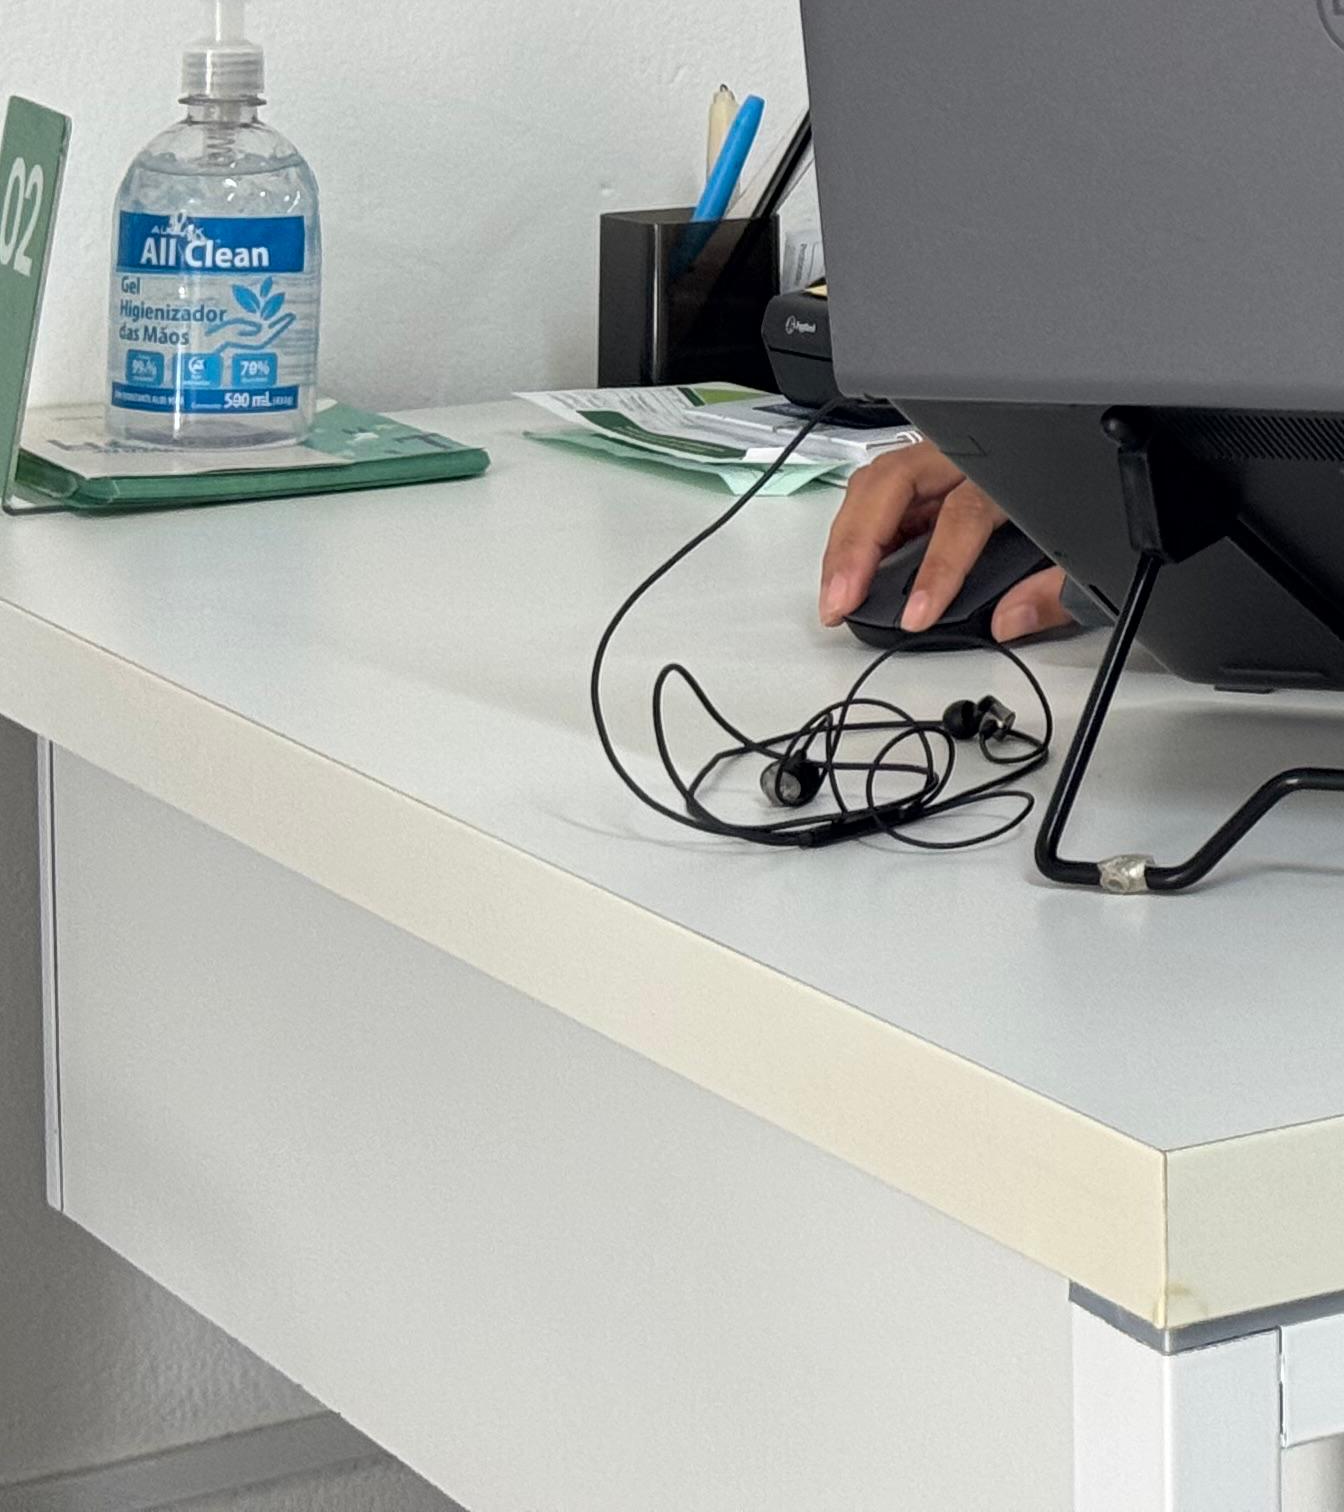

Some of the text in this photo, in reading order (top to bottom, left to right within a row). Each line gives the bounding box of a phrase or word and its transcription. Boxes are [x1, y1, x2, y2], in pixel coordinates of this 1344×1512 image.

[0, 156, 44, 277] 02
[140, 237, 270, 268] All Clean
[121, 275, 140, 294] Gel
[120, 299, 227, 322] Higienizador
[119, 322, 190, 345] das Mãos
[223, 393, 249, 409] 500
